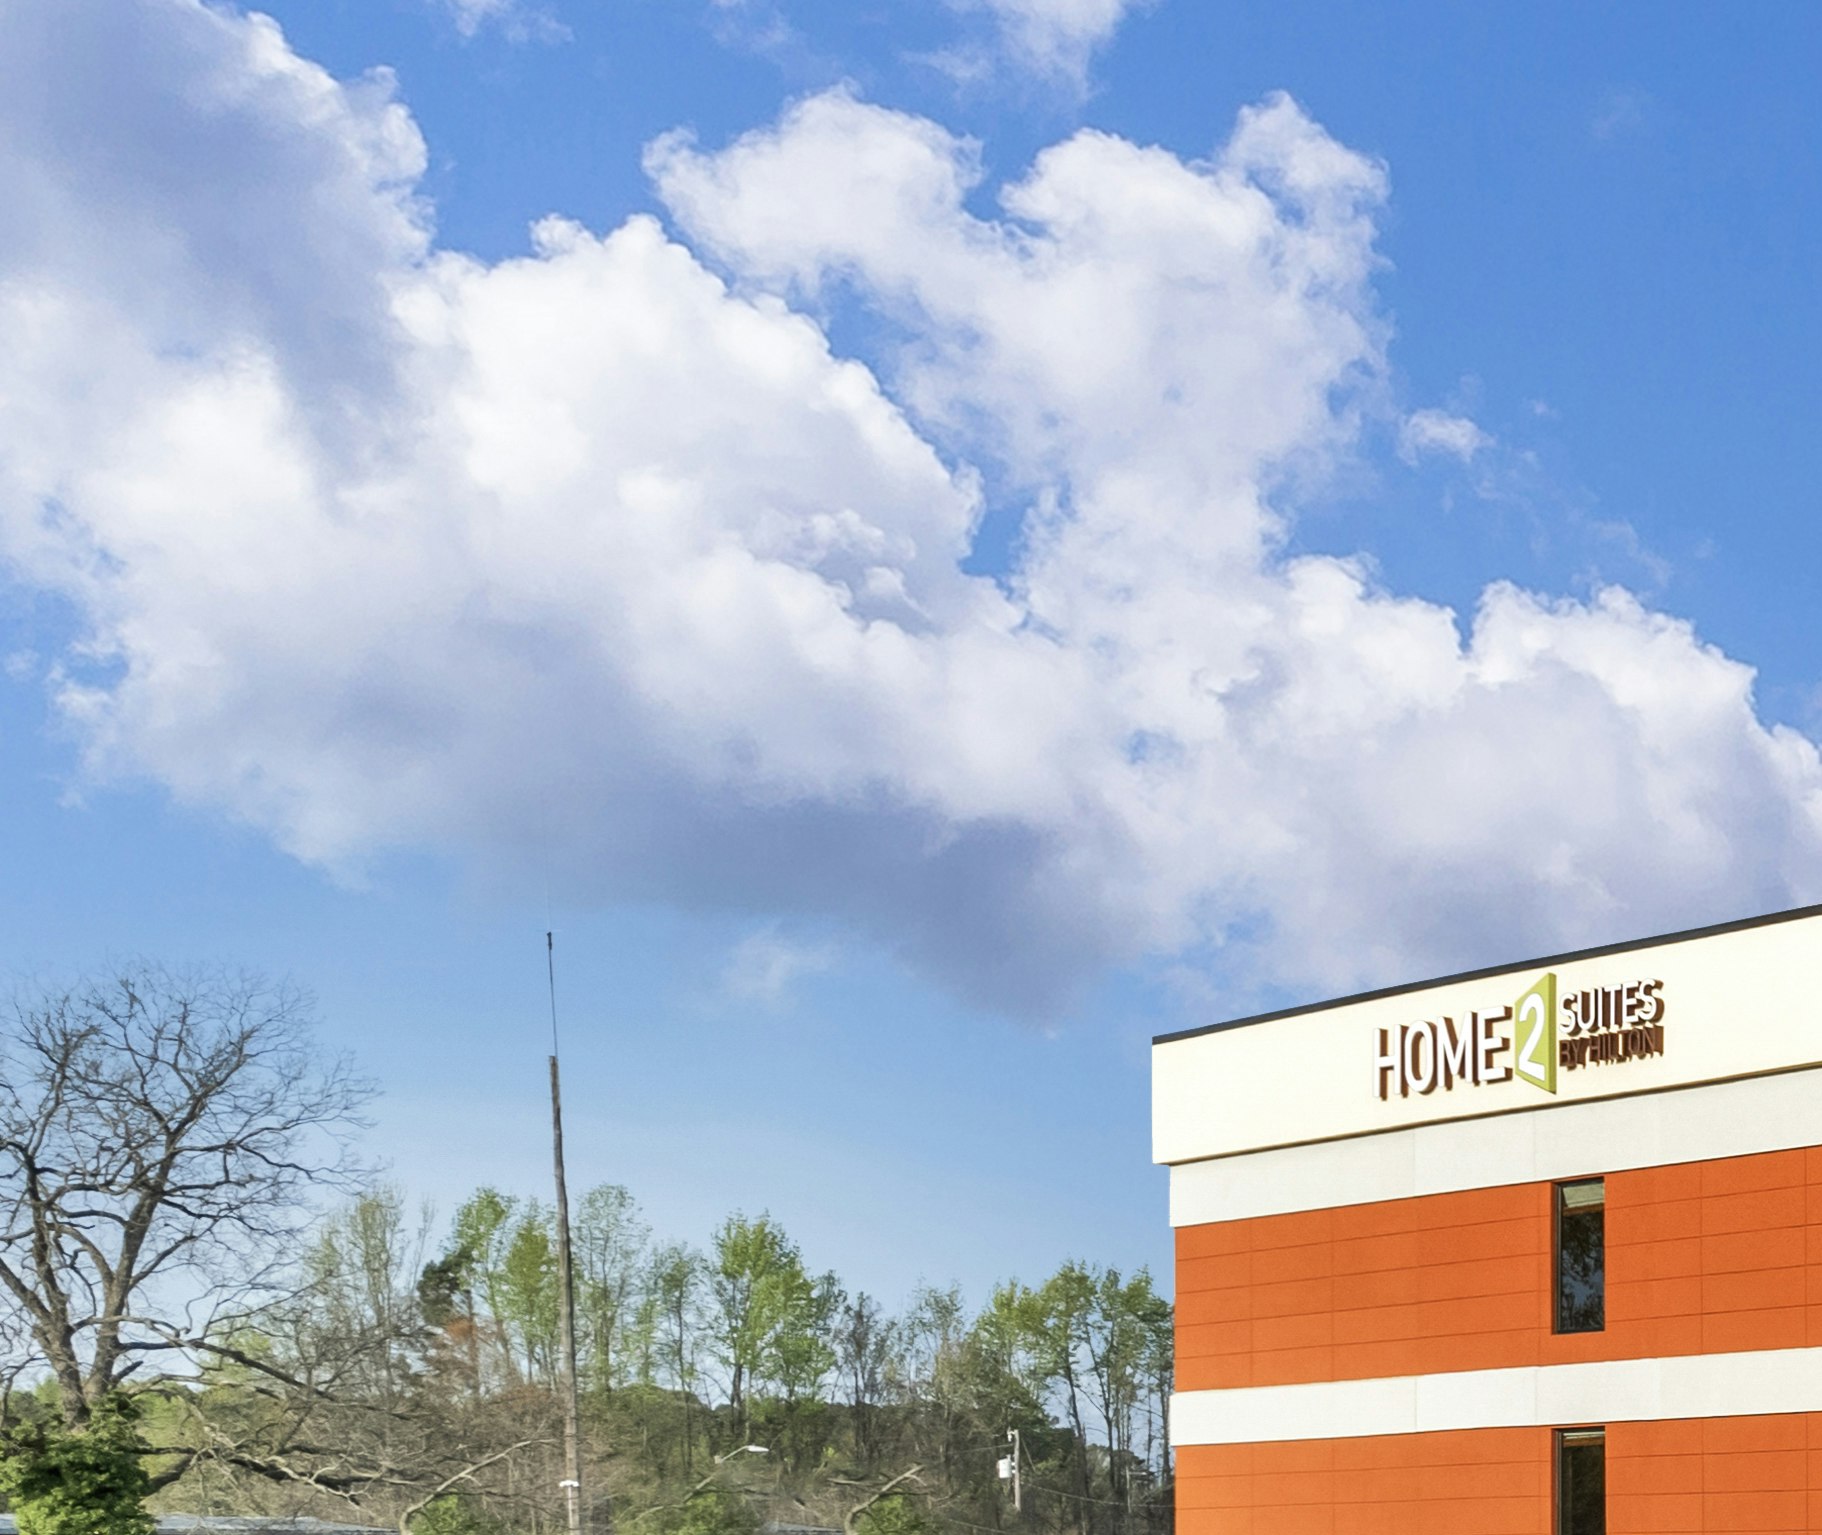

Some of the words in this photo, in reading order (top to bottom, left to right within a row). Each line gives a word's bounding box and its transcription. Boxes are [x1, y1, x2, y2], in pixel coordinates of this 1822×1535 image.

[1558, 978, 1665, 1036] SUITES
[1559, 1036, 1587, 1071] BY
[1588, 1024, 1664, 1067] HILTON
